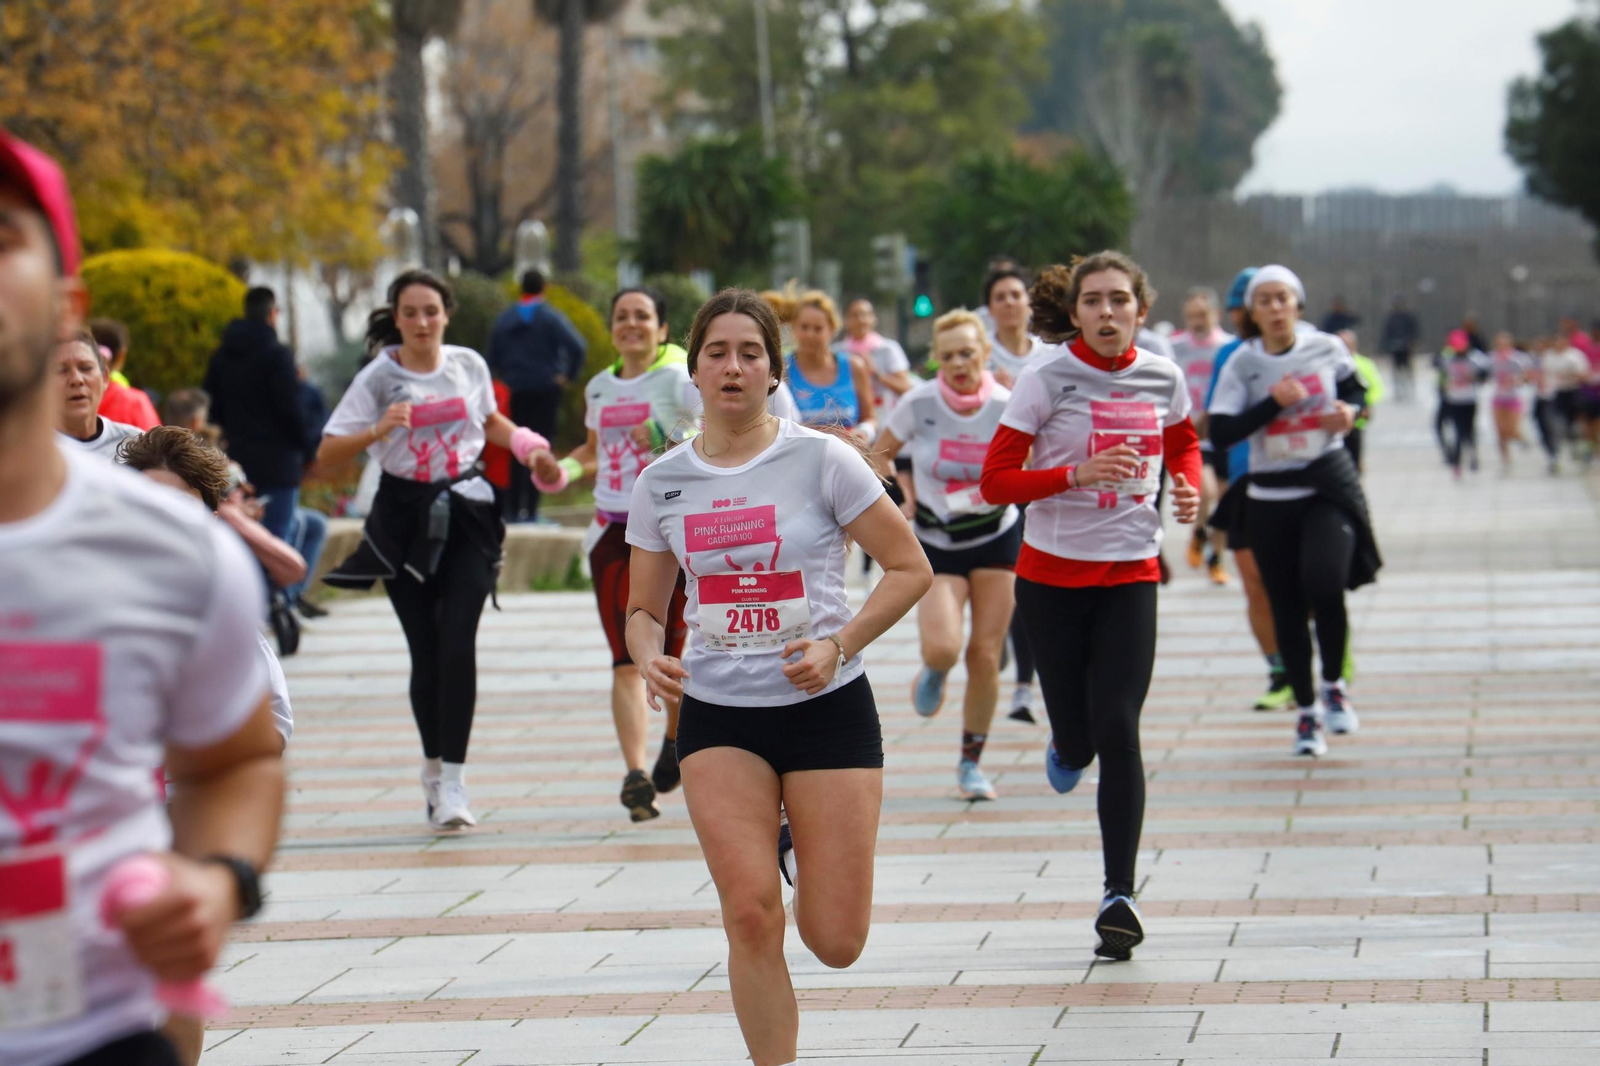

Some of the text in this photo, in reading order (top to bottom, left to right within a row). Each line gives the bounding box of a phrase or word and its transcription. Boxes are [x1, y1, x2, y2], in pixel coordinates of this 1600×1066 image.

[694, 518, 765, 536] PINK RUNNING
[707, 532, 752, 545] CADENA 100
[739, 577, 757, 586] 100
[726, 607, 780, 633] 2478
